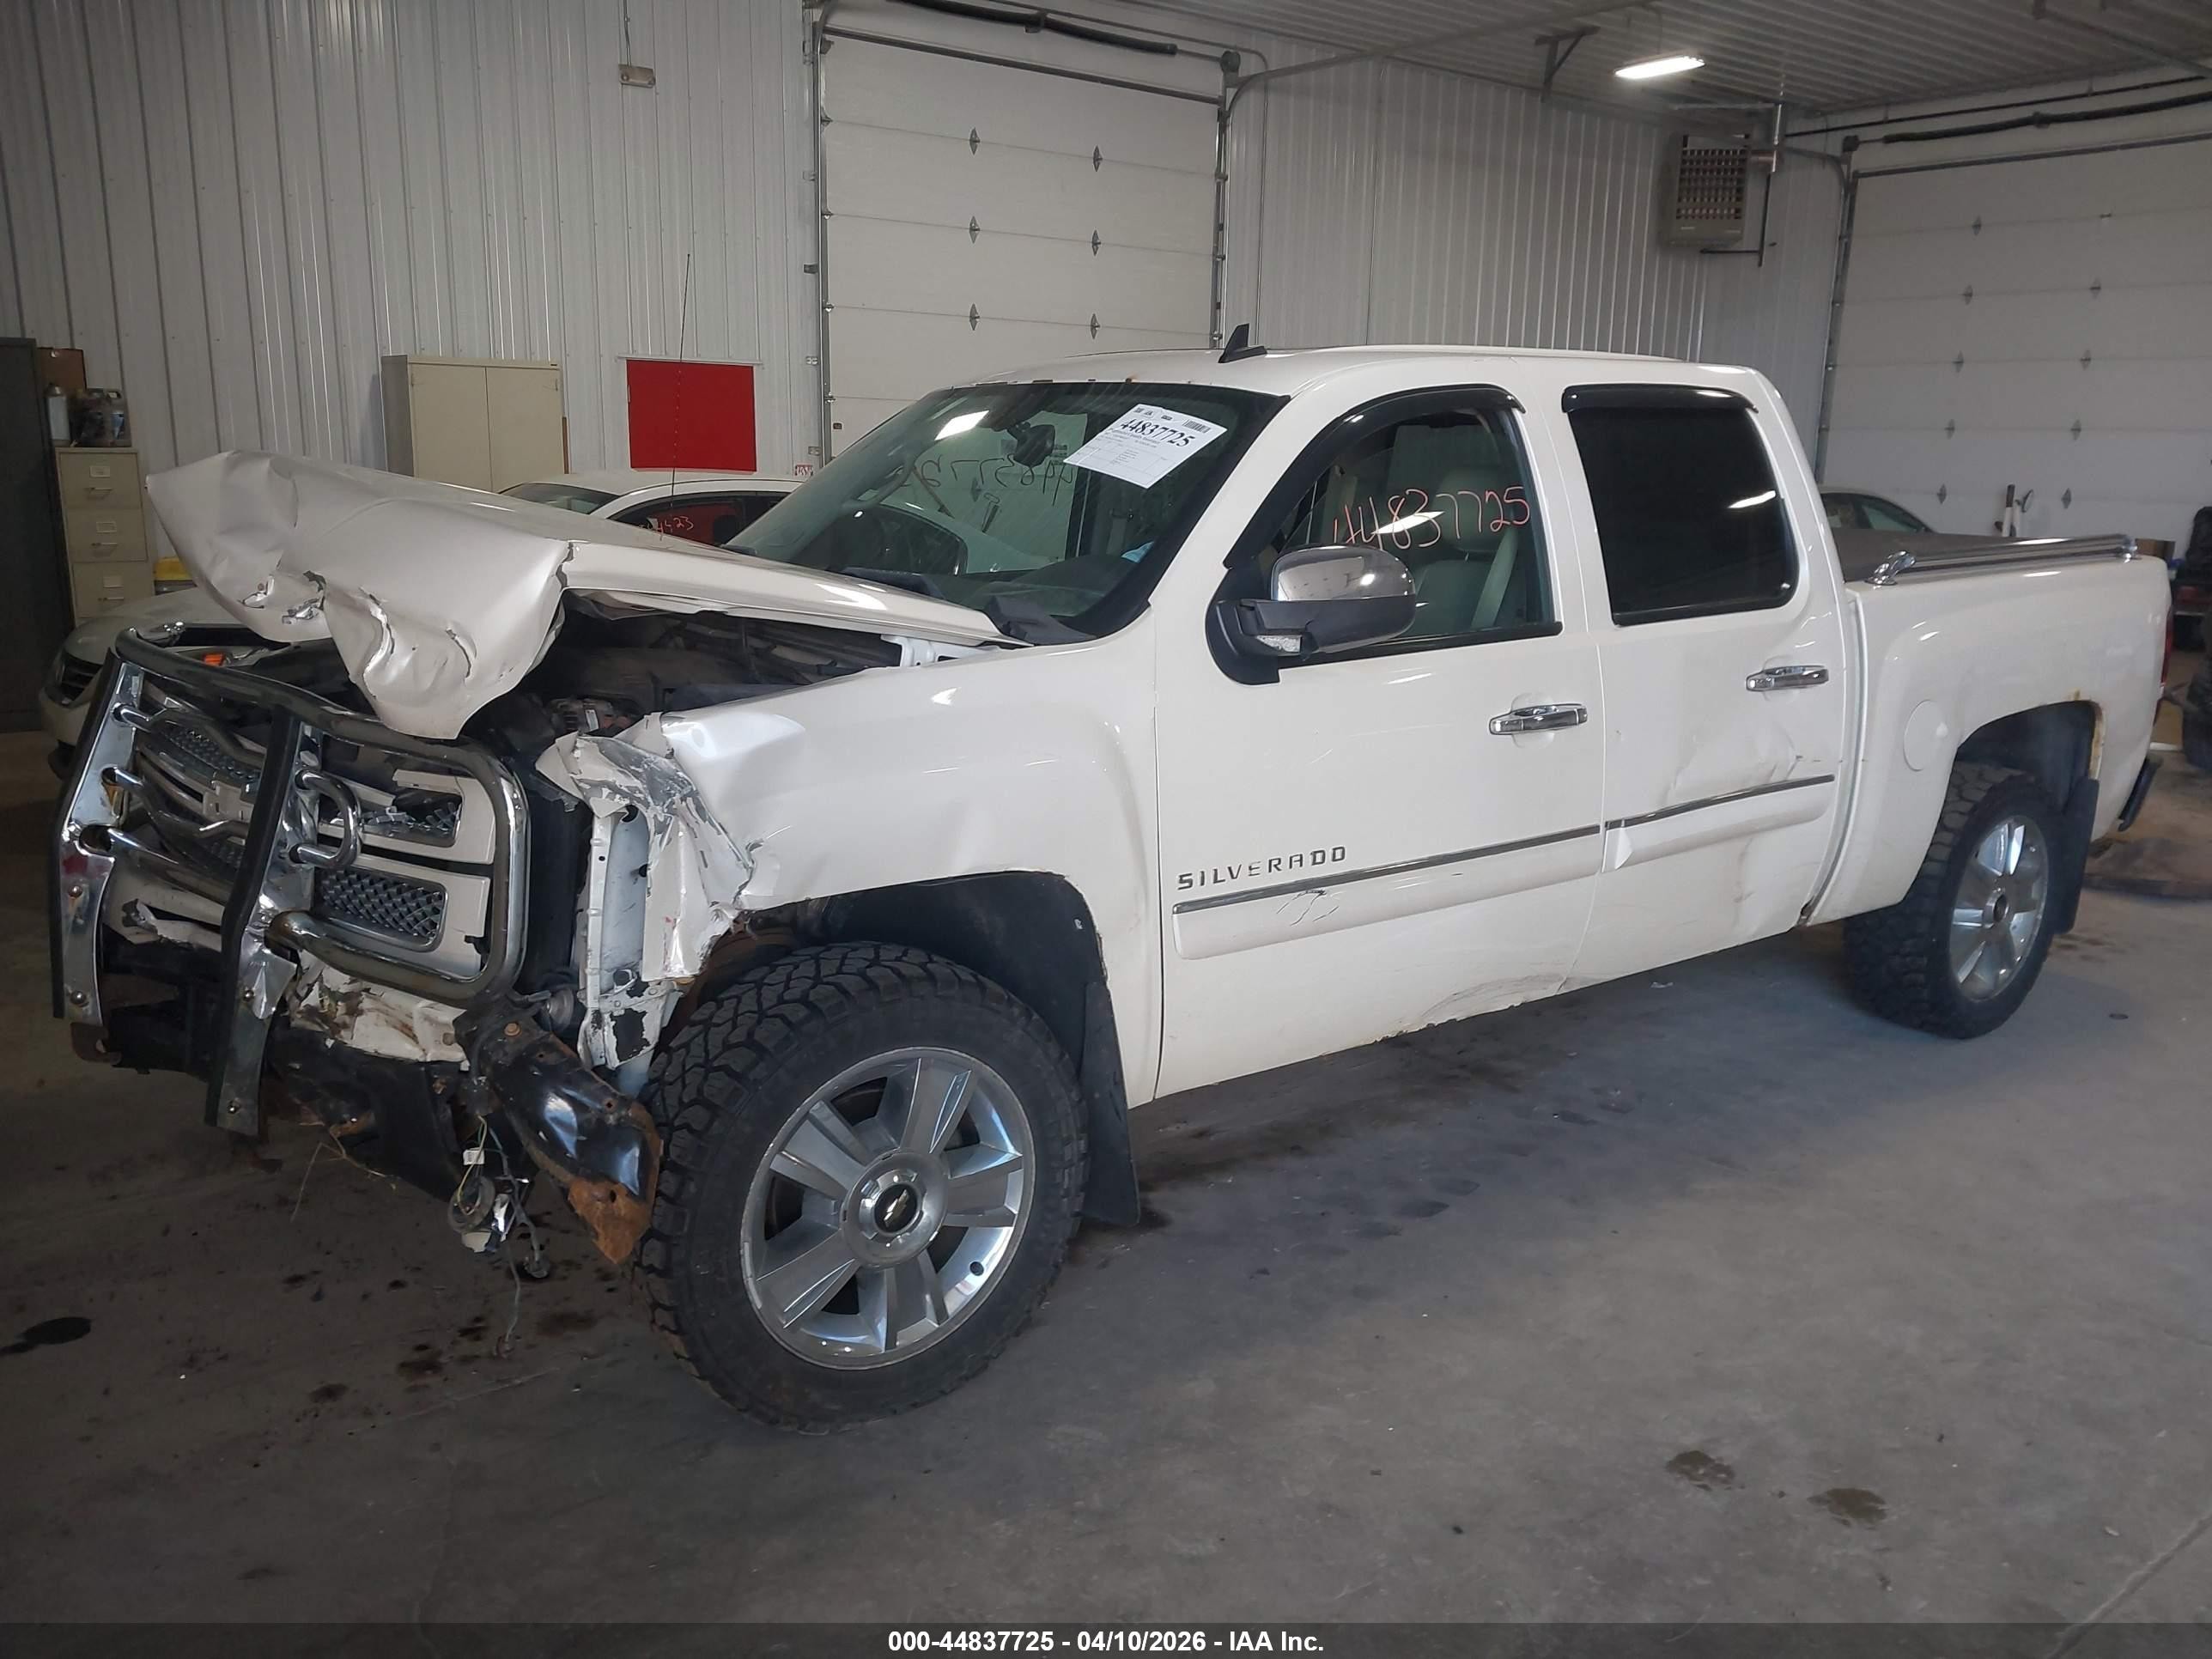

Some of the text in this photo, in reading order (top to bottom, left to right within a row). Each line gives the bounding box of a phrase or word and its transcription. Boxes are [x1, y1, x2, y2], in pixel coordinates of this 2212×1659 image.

[1121, 418, 1195, 447] 44837725
[1333, 486, 1530, 550] 44837725
[1177, 845, 1346, 890] SILVERADO
